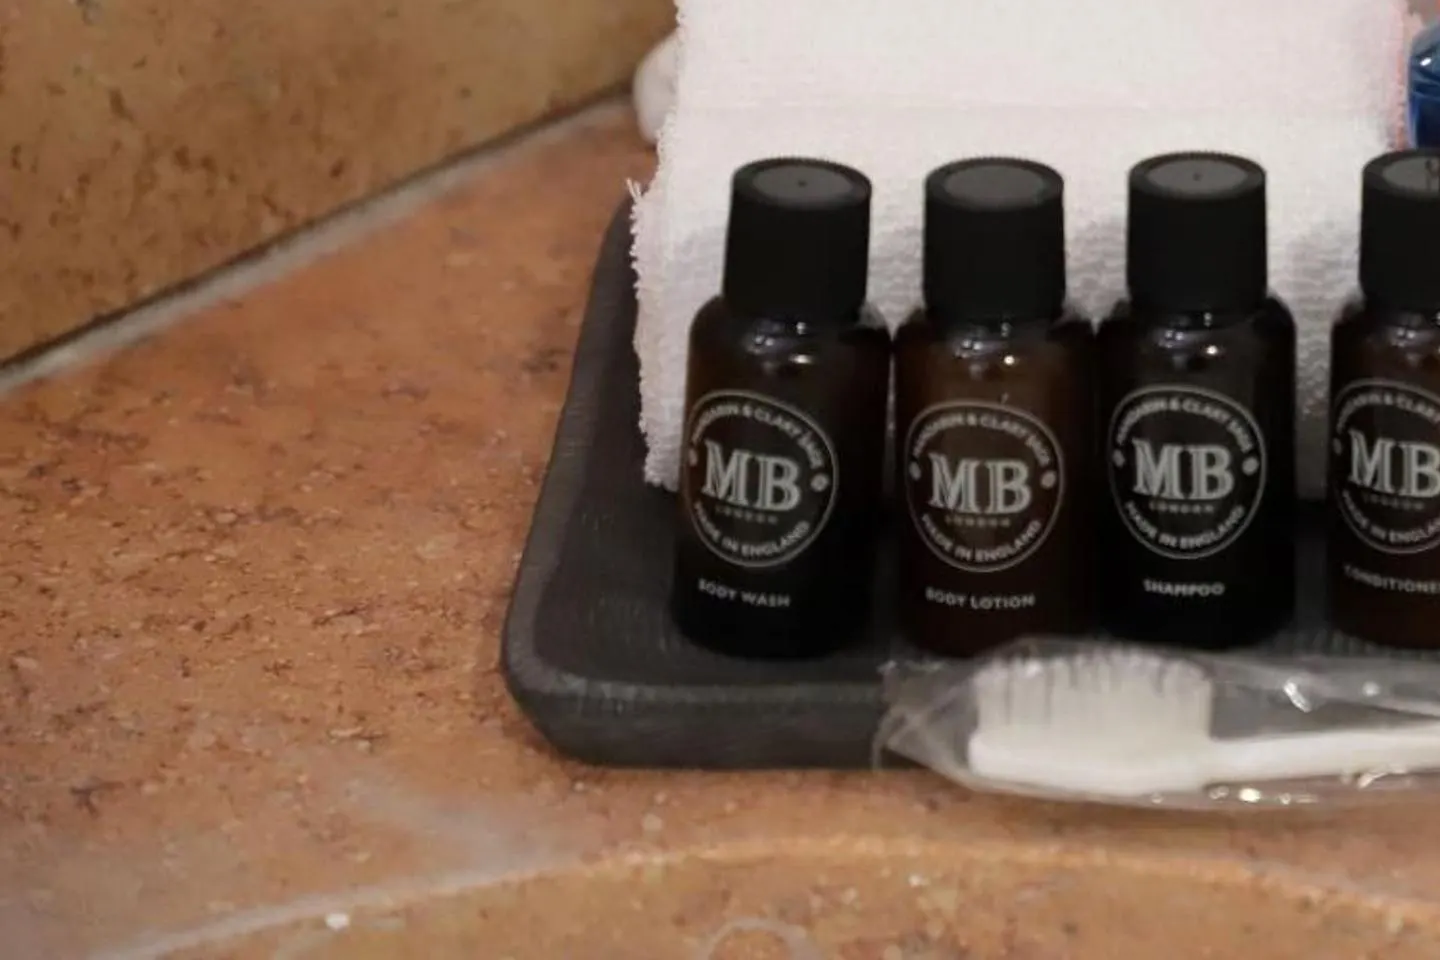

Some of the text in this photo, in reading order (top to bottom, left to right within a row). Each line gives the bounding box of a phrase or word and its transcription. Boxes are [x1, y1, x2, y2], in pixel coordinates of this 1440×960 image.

[699, 438, 801, 511] MB
[927, 452, 1033, 514] MB
[1131, 437, 1235, 500] MB
[698, 577, 792, 609] BODY WASH
[925, 586, 1036, 610] BODY LOTION
[1142, 578, 1225, 598] SHAMPOO
